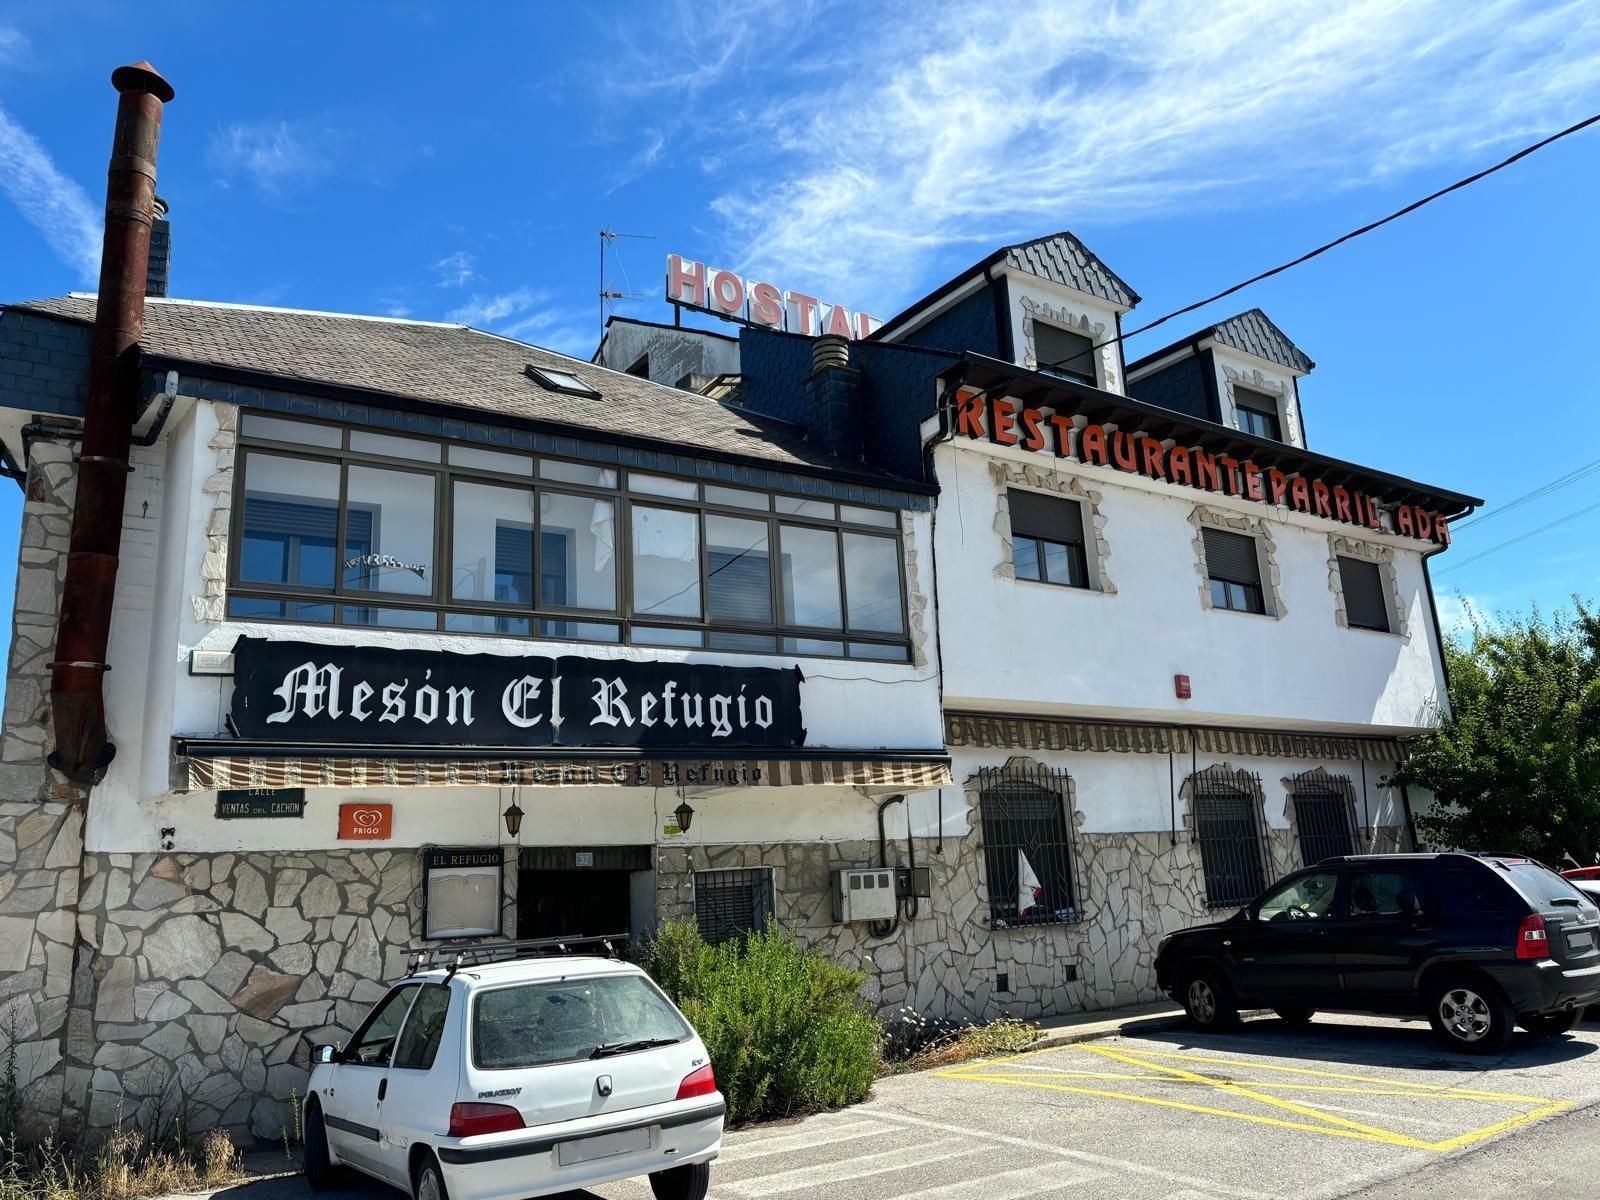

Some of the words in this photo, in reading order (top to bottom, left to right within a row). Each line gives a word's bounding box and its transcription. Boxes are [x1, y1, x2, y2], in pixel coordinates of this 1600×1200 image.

[955, 388, 1265, 501] RESTAURANTE
[266, 661, 475, 727] Mesón
[502, 675, 566, 729] El
[590, 676, 775, 739] Refugio
[1261, 736, 1360, 758] HABITACIONES
[663, 761, 763, 786] Refugio
[249, 788, 276, 796] CALLE
[221, 802, 250, 814] VENTAS
[353, 827, 379, 835] FRIGO
[433, 855, 447, 866] EL
[451, 854, 499, 865] REFUGIO
[579, 855, 589, 865] 32
